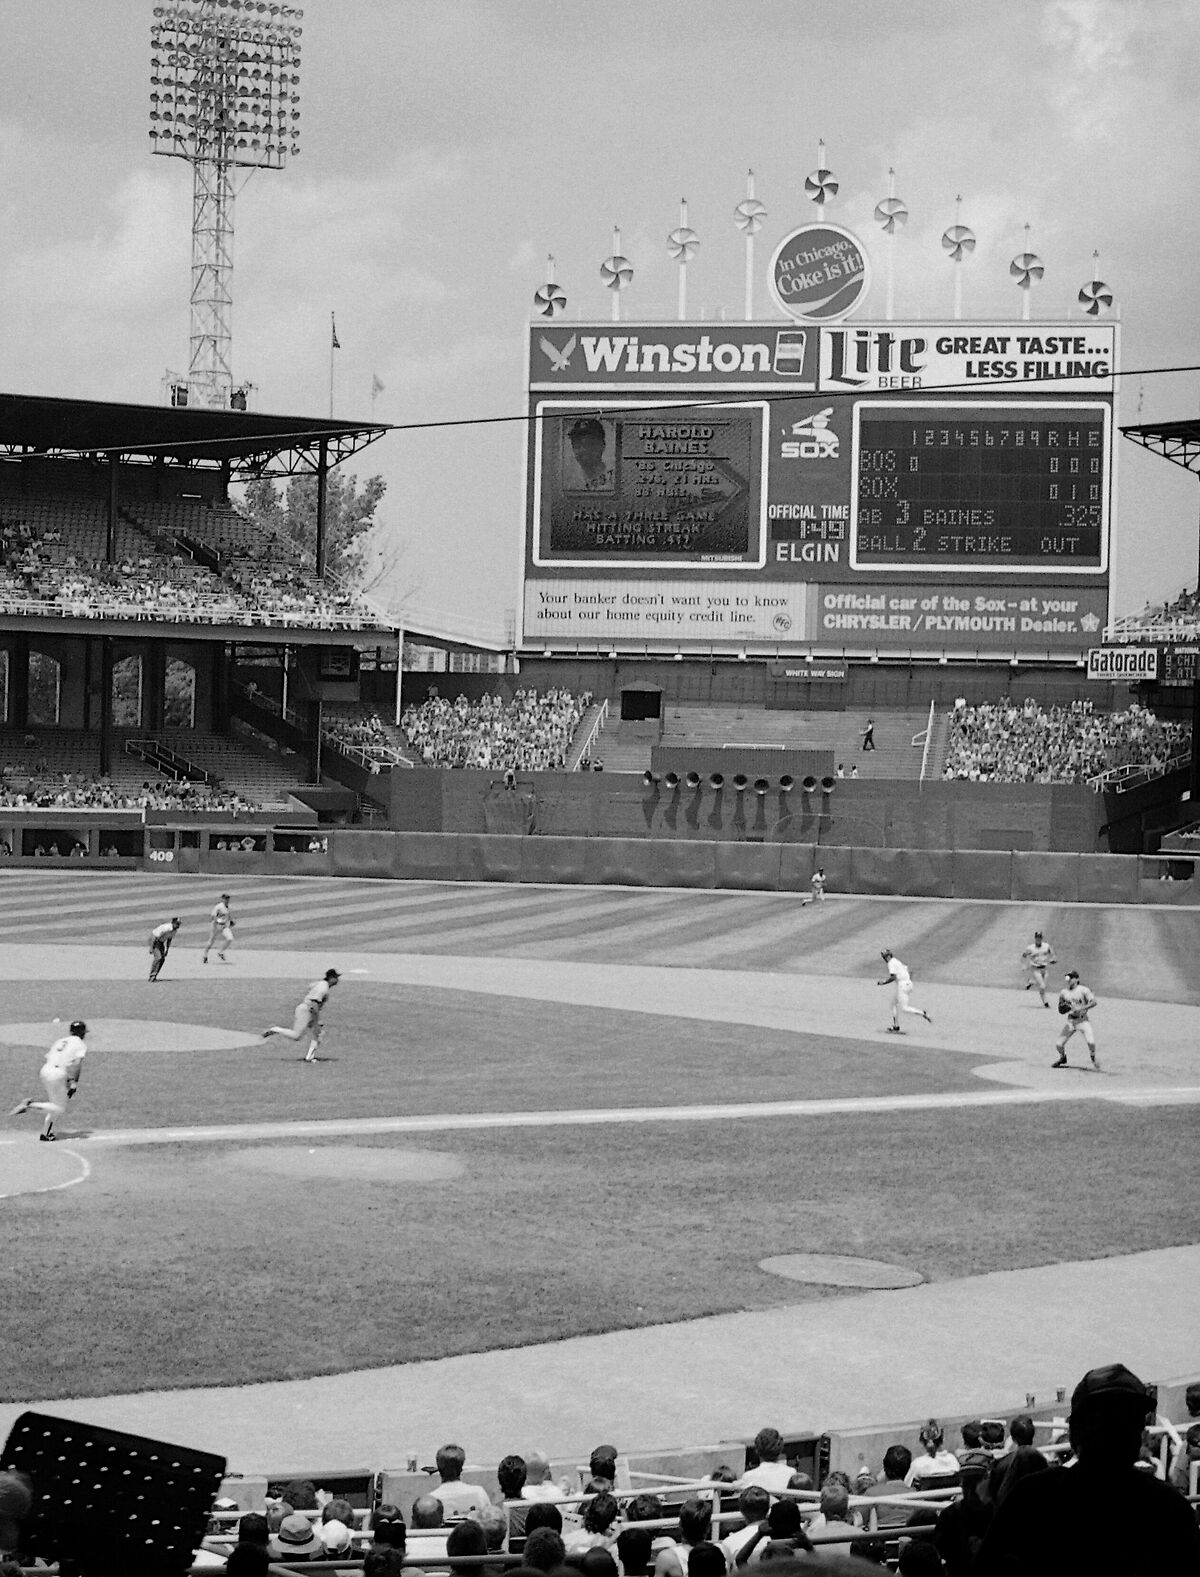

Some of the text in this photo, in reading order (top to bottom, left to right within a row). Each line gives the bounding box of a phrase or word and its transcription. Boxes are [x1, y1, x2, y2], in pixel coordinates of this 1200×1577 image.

[779, 258, 795, 272] In
[778, 253, 864, 295] Coke is it!
[936, 337, 1109, 354] GREAT TASTE...
[581, 335, 773, 375] Winston
[825, 331, 928, 388] Lite
[966, 361, 1109, 379] LESS FILLING
[879, 376, 921, 388] BEER
[639, 426, 714, 440] HAROLD
[1048, 431, 1059, 446] R
[1068, 431, 1079, 446] H
[1088, 431, 1099, 447] E
[644, 441, 708, 454] BAINES
[781, 442, 840, 458] SOX
[664, 461, 715, 474] Chicago
[860, 450, 896, 471] BOS
[859, 477, 898, 498] SOX
[768, 505, 849, 519] OFFICIAL TIME
[859, 500, 1101, 527] AB 3 BAINES .325
[587, 523, 700, 533] HITTING STREAK
[800, 520, 845, 539] 1:49
[596, 534, 655, 544] BATTING
[858, 527, 1080, 552] BALL 2 STRIKE OUT
[776, 543, 839, 562] ELGIN
[539, 592, 788, 609] Your banker doesn't want you to know
[824, 594, 886, 610] Official
[889, 597, 917, 611] car
[921, 595, 939, 611] of
[942, 596, 970, 612] the
[1041, 600, 1078, 615] your
[537, 609, 756, 624] about our home equity credit line.
[1021, 617, 1077, 633] Dealer.
[1090, 650, 1155, 672] Gatorade
[1177, 655, 1196, 666] CHI
[826, 670, 845, 678] SIGN
[1177, 667, 1196, 679] ATL
[150, 851, 173, 862] 409
